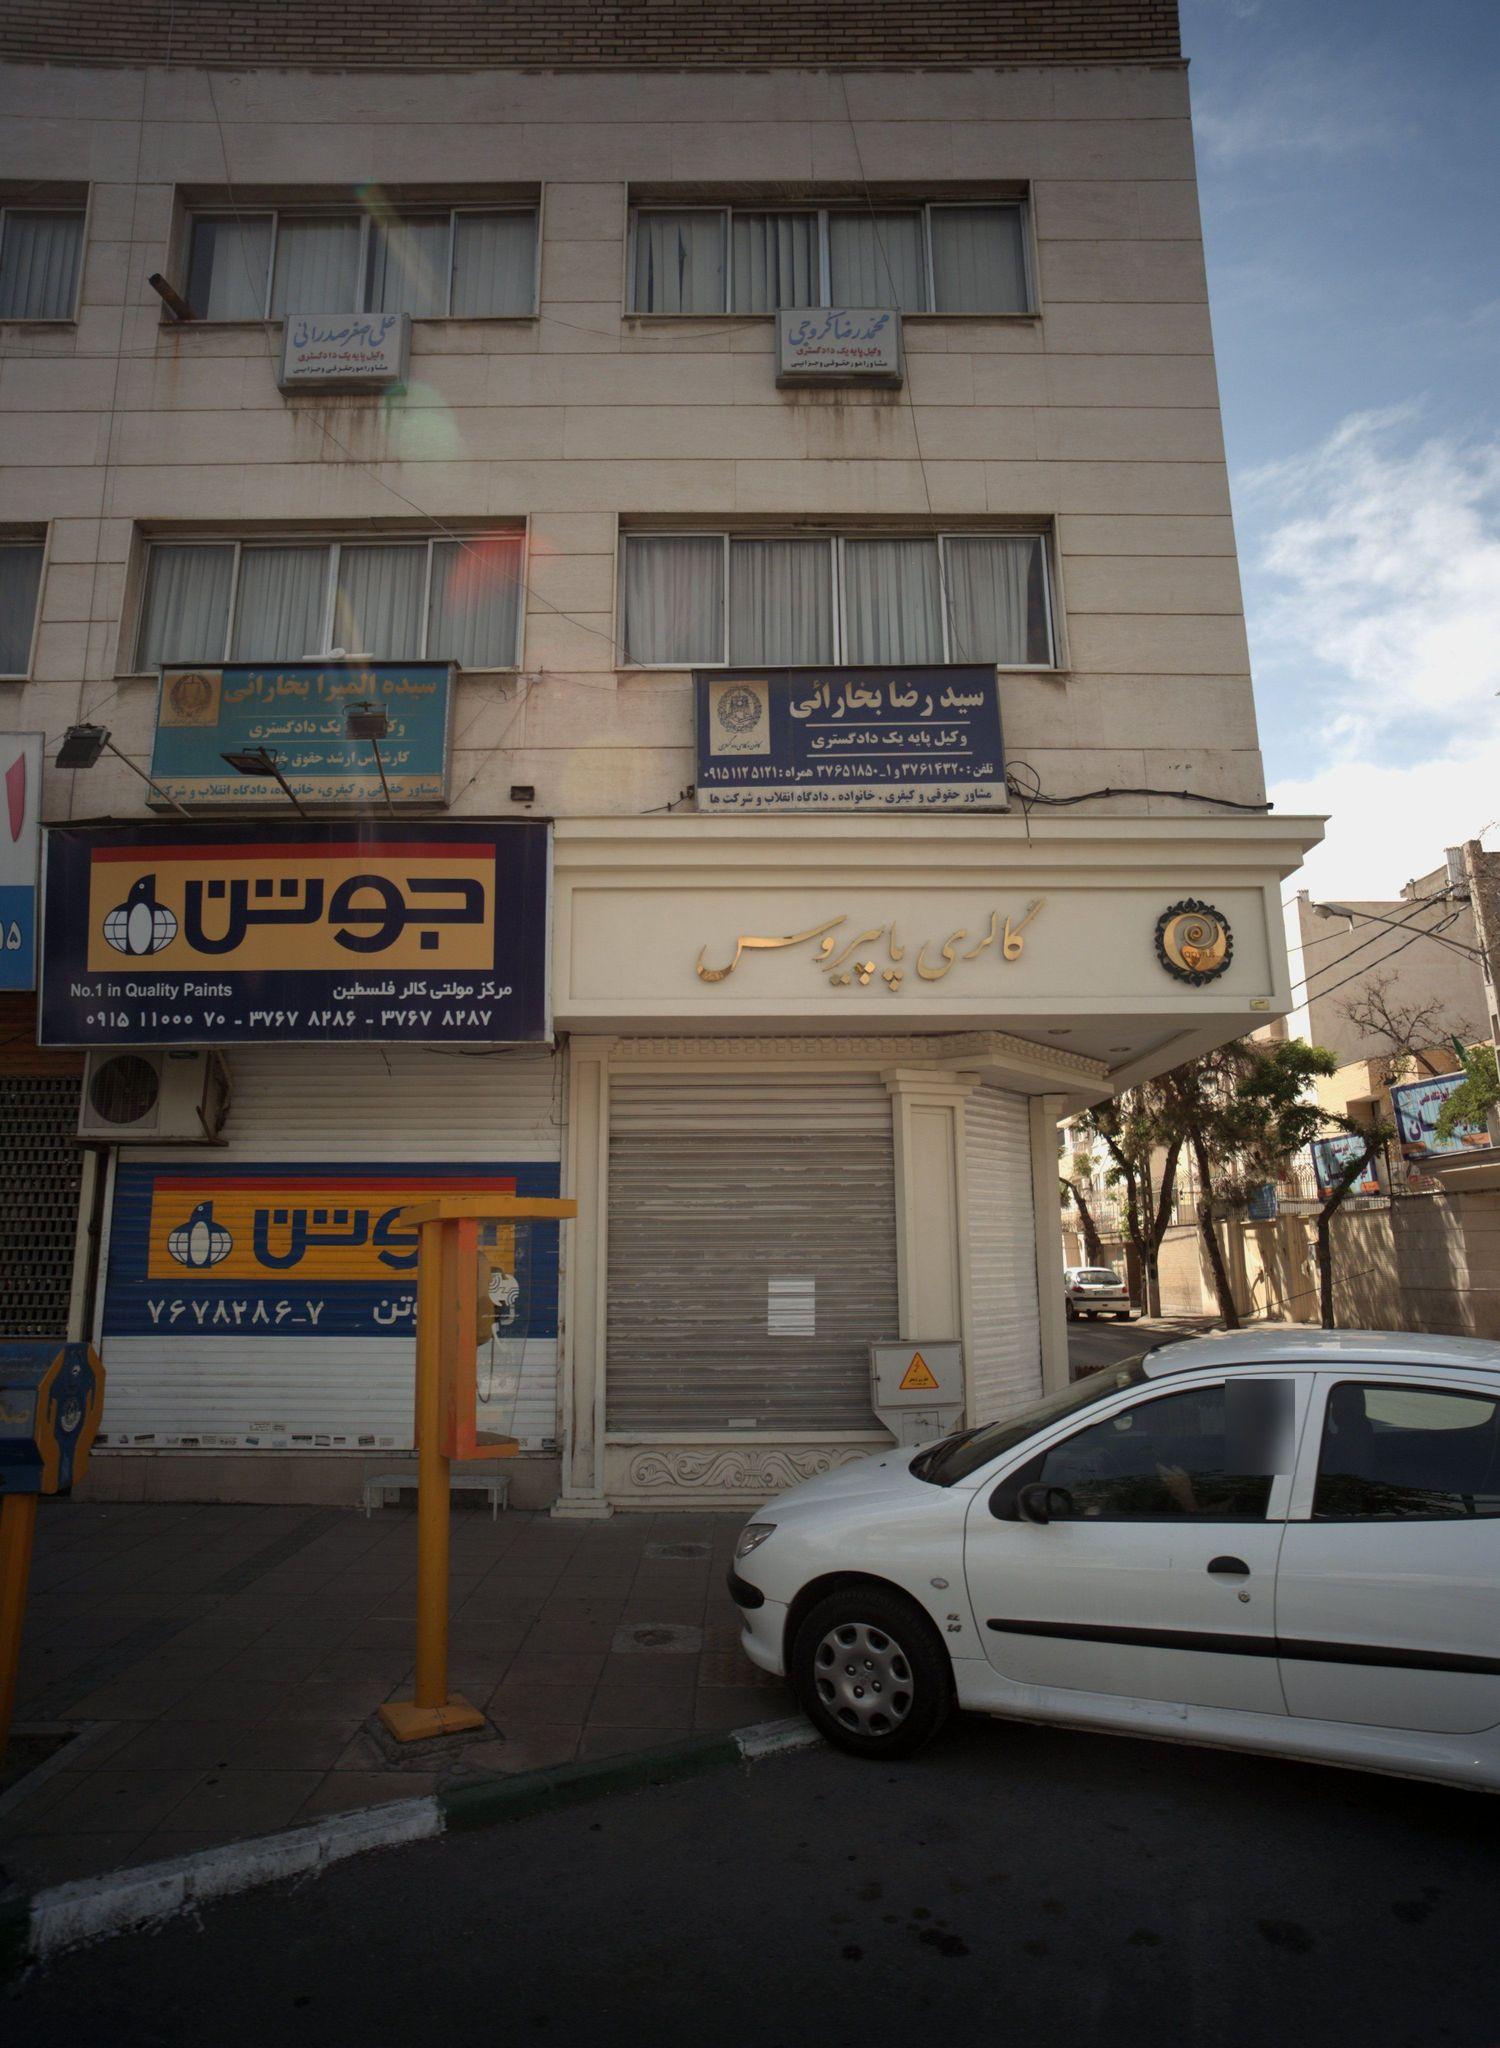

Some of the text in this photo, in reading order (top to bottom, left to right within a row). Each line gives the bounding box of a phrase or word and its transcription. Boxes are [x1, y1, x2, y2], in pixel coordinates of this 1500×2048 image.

[382, 678, 437, 700] سیده
[888, 680, 934, 717] رضا
[939, 686, 985, 715] سید
[248, 719, 317, 739] دادگستری
[319, 719, 341, 737] یک
[811, 730, 968, 749] وکیل پایه یک دادگستری
[291, 751, 324, 768] حقوق
[325, 751, 356, 767] ارشد
[233, 784, 267, 796] دادگاه
[764, 792, 794, 805] انقلاب
[796, 791, 829, 802] دادگاه
[927, 788, 961, 803] حقوقی
[964, 788, 992, 803] مشاور
[70, 983, 233, 1000] No.1 in Quality Paints
[332, 980, 513, 1000] مرکز مولتی کالر فلسطین
[253, 1206, 419, 1270] وتن
